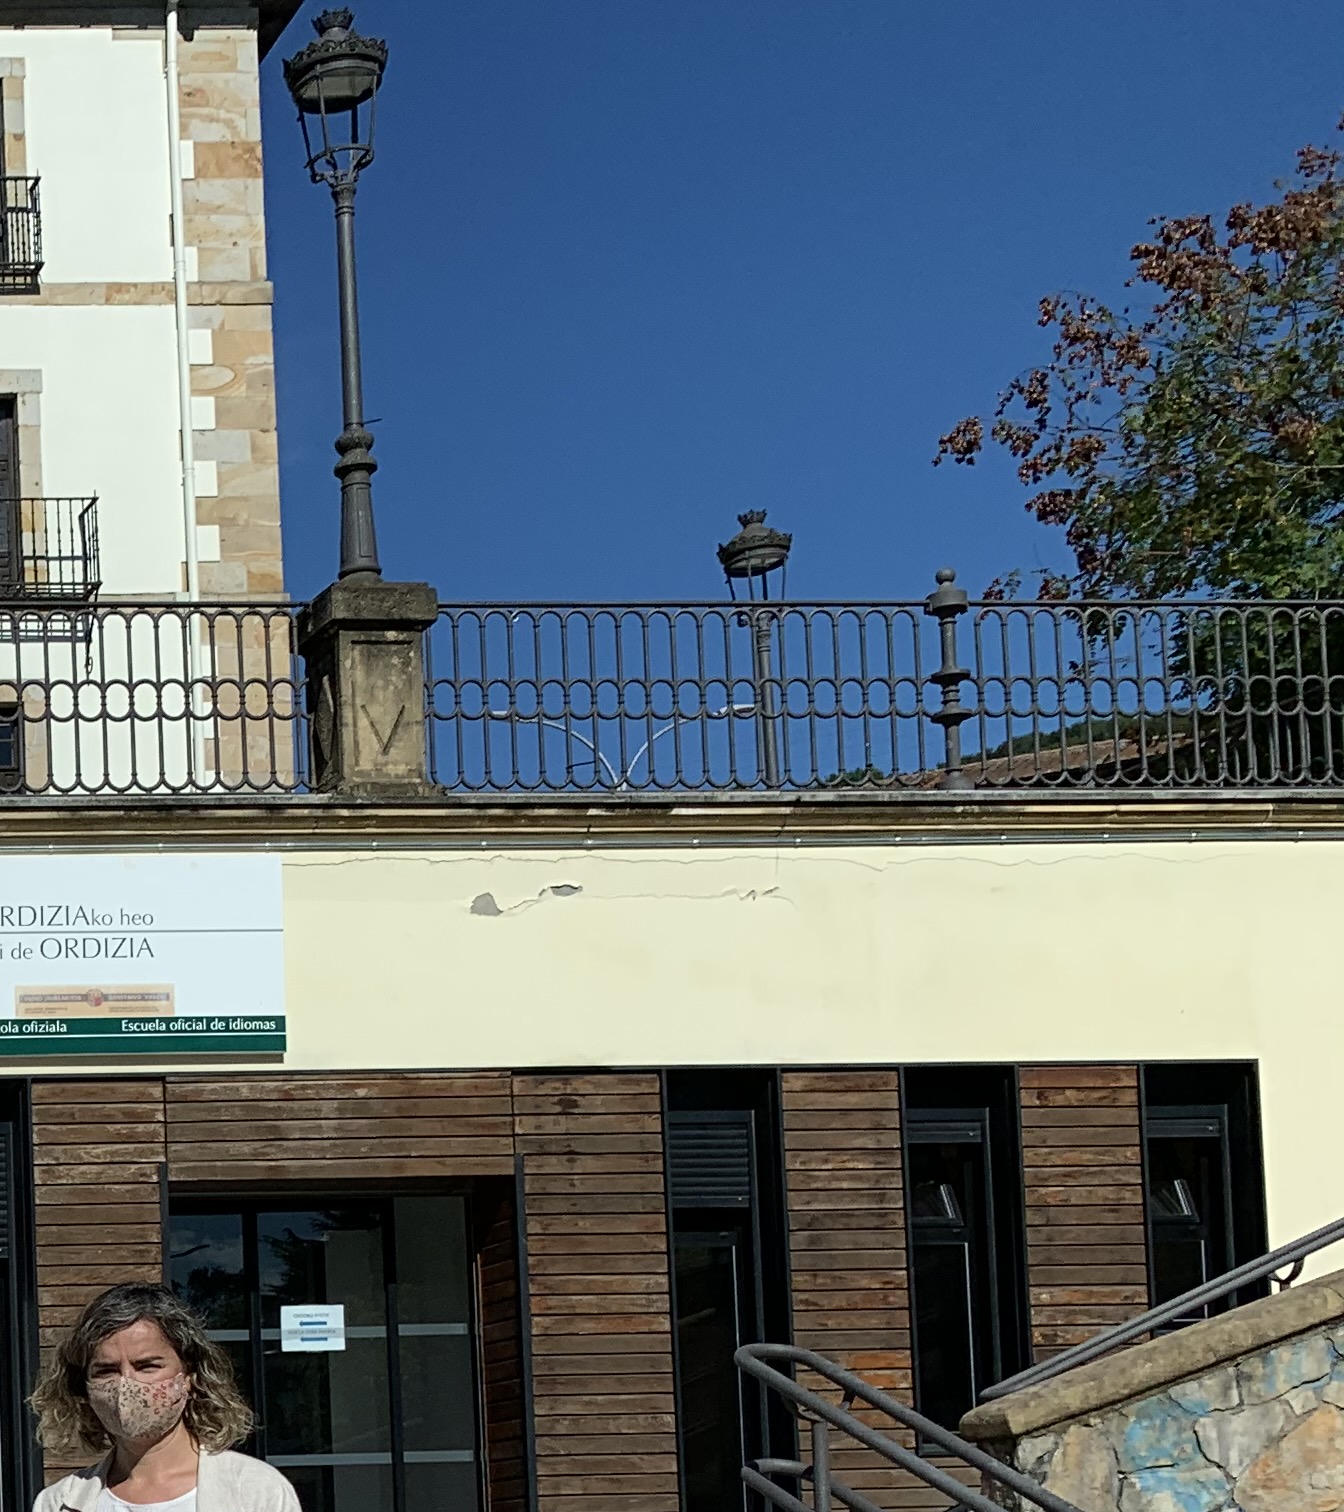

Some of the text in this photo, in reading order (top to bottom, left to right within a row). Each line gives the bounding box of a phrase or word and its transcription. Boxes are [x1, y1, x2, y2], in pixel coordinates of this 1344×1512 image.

[120, 907, 154, 926] heo
[11, 942, 33, 960] de
[40, 937, 155, 960] ORDIZIA
[22, 1020, 68, 1033] ofiziala
[121, 1017, 276, 1032] Escuela oficial de idiomas
